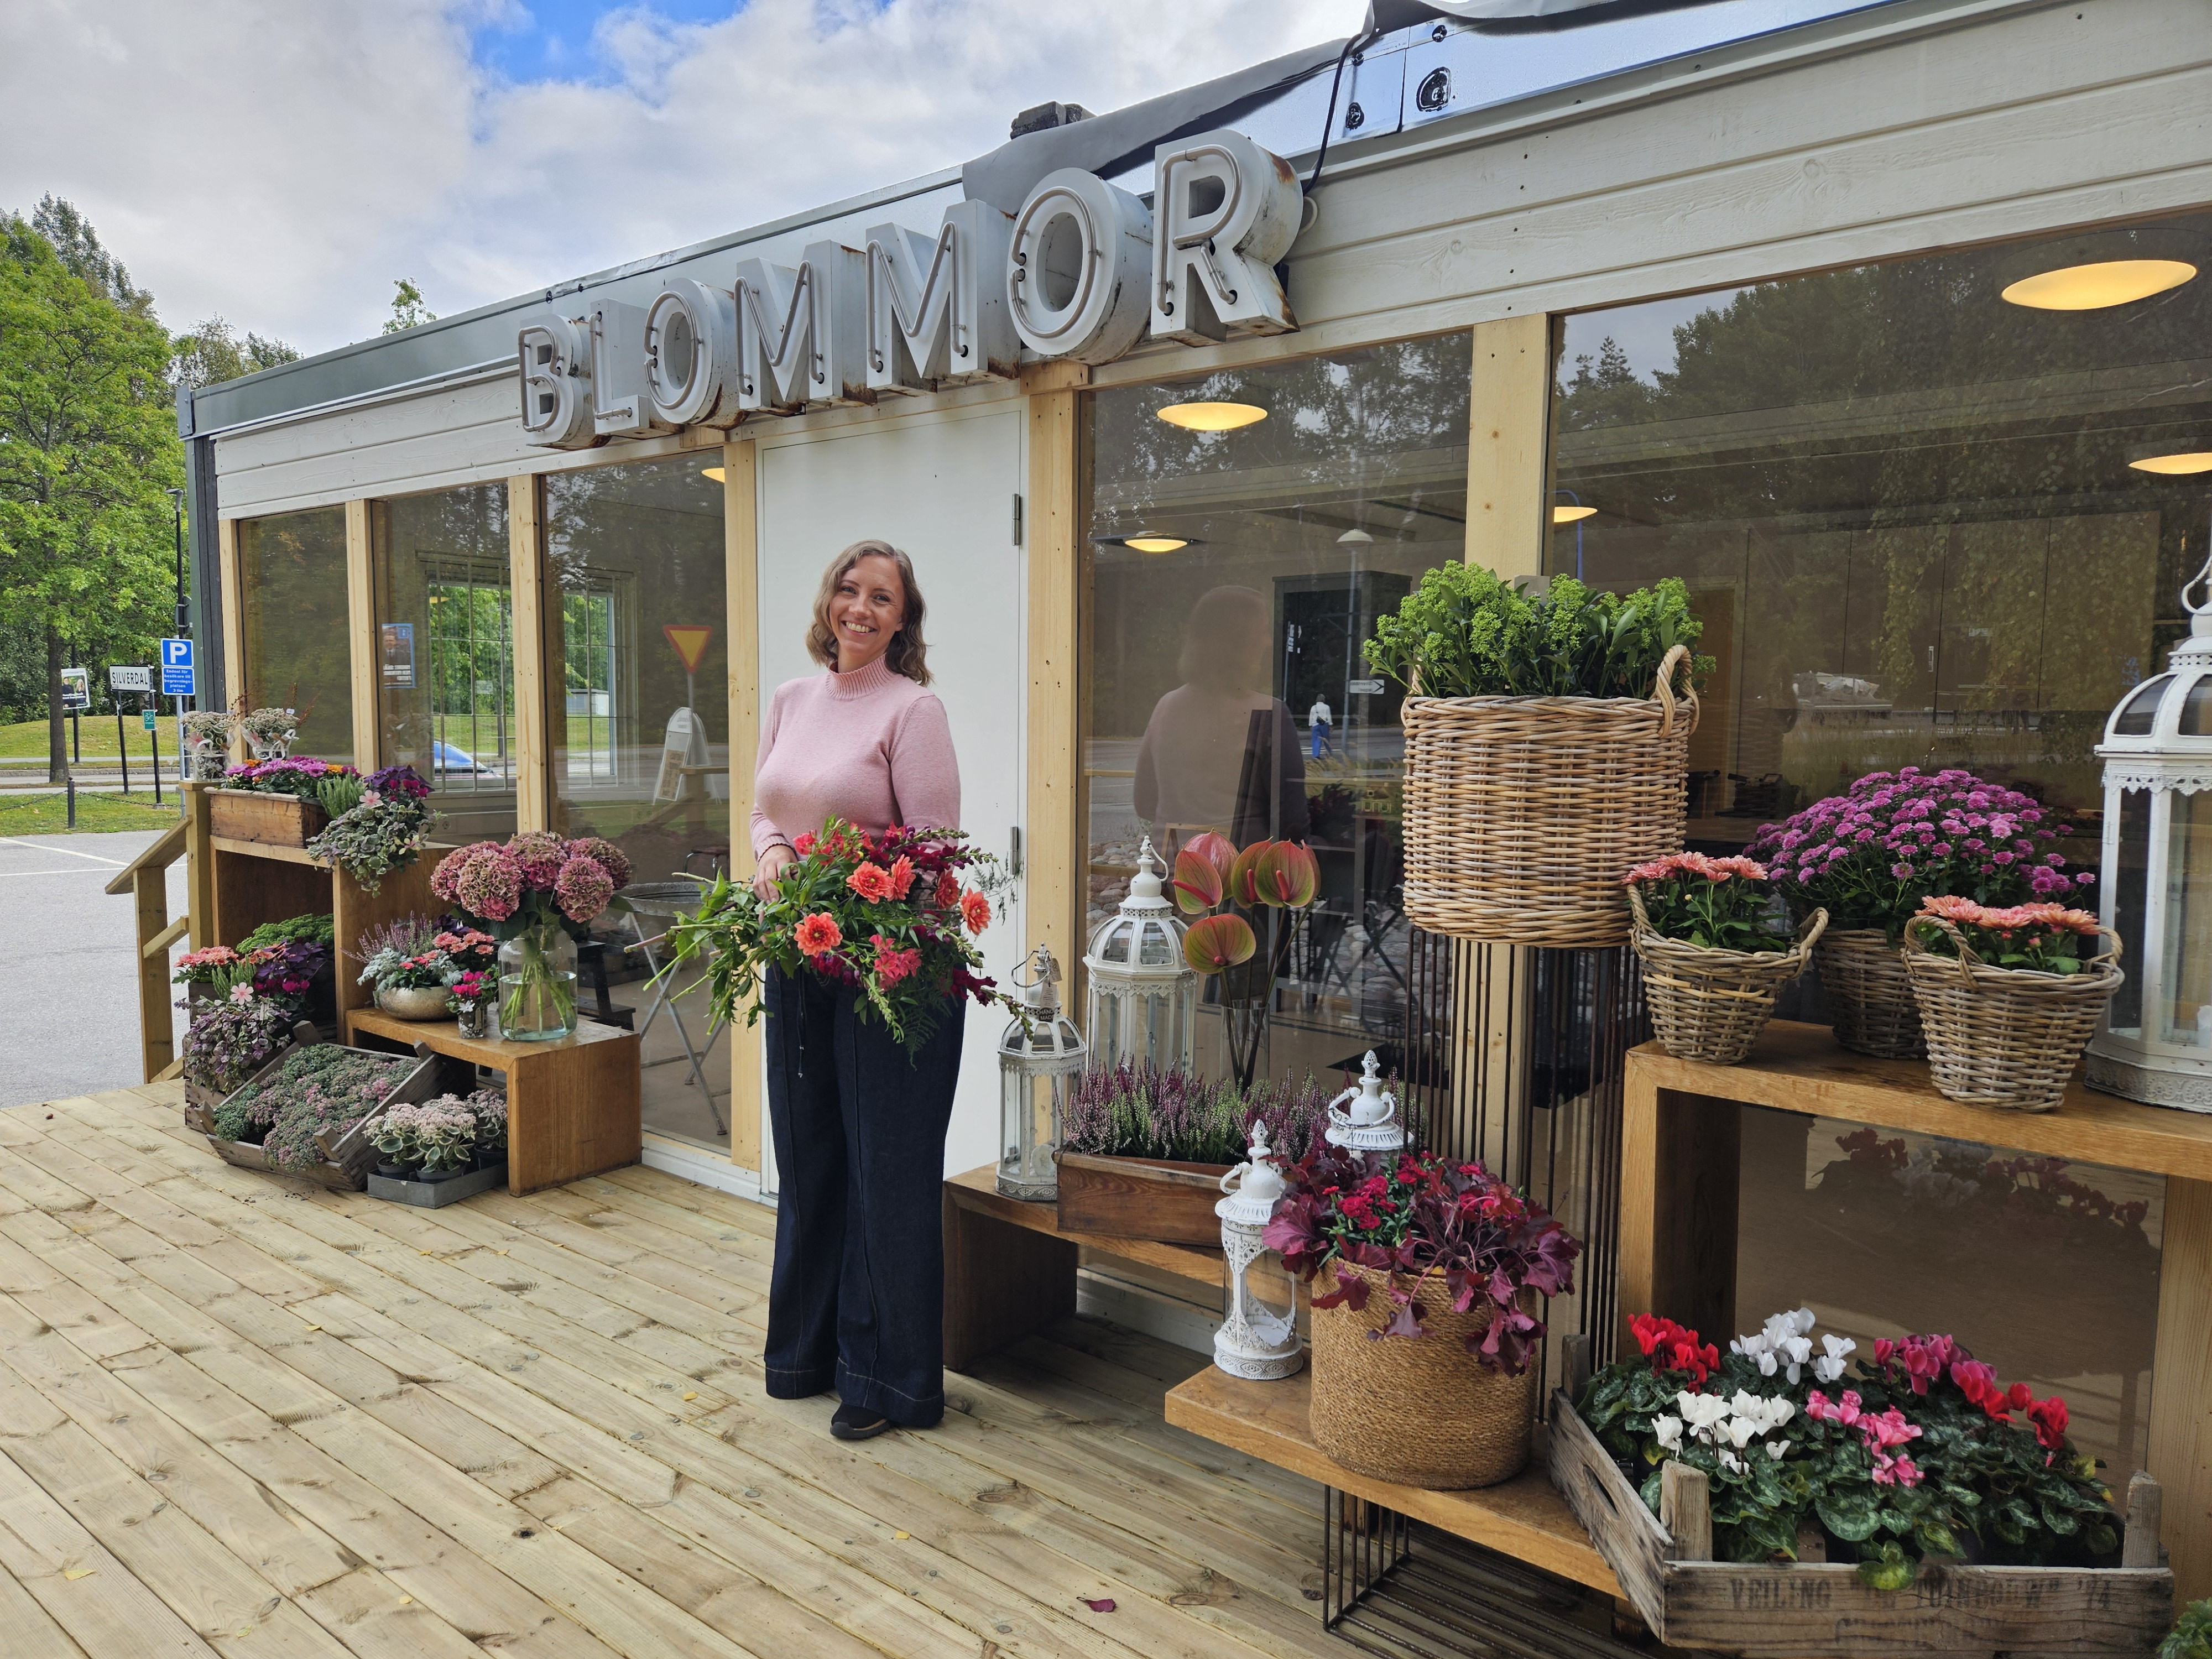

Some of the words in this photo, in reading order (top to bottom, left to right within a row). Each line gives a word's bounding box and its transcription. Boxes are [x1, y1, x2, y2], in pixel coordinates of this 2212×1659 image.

[518, 128, 1302, 449] BLOMMOR
[170, 642, 187, 664] P
[112, 672, 148, 685] SILVERDAL
[1730, 1578, 1833, 1609] VEILING
